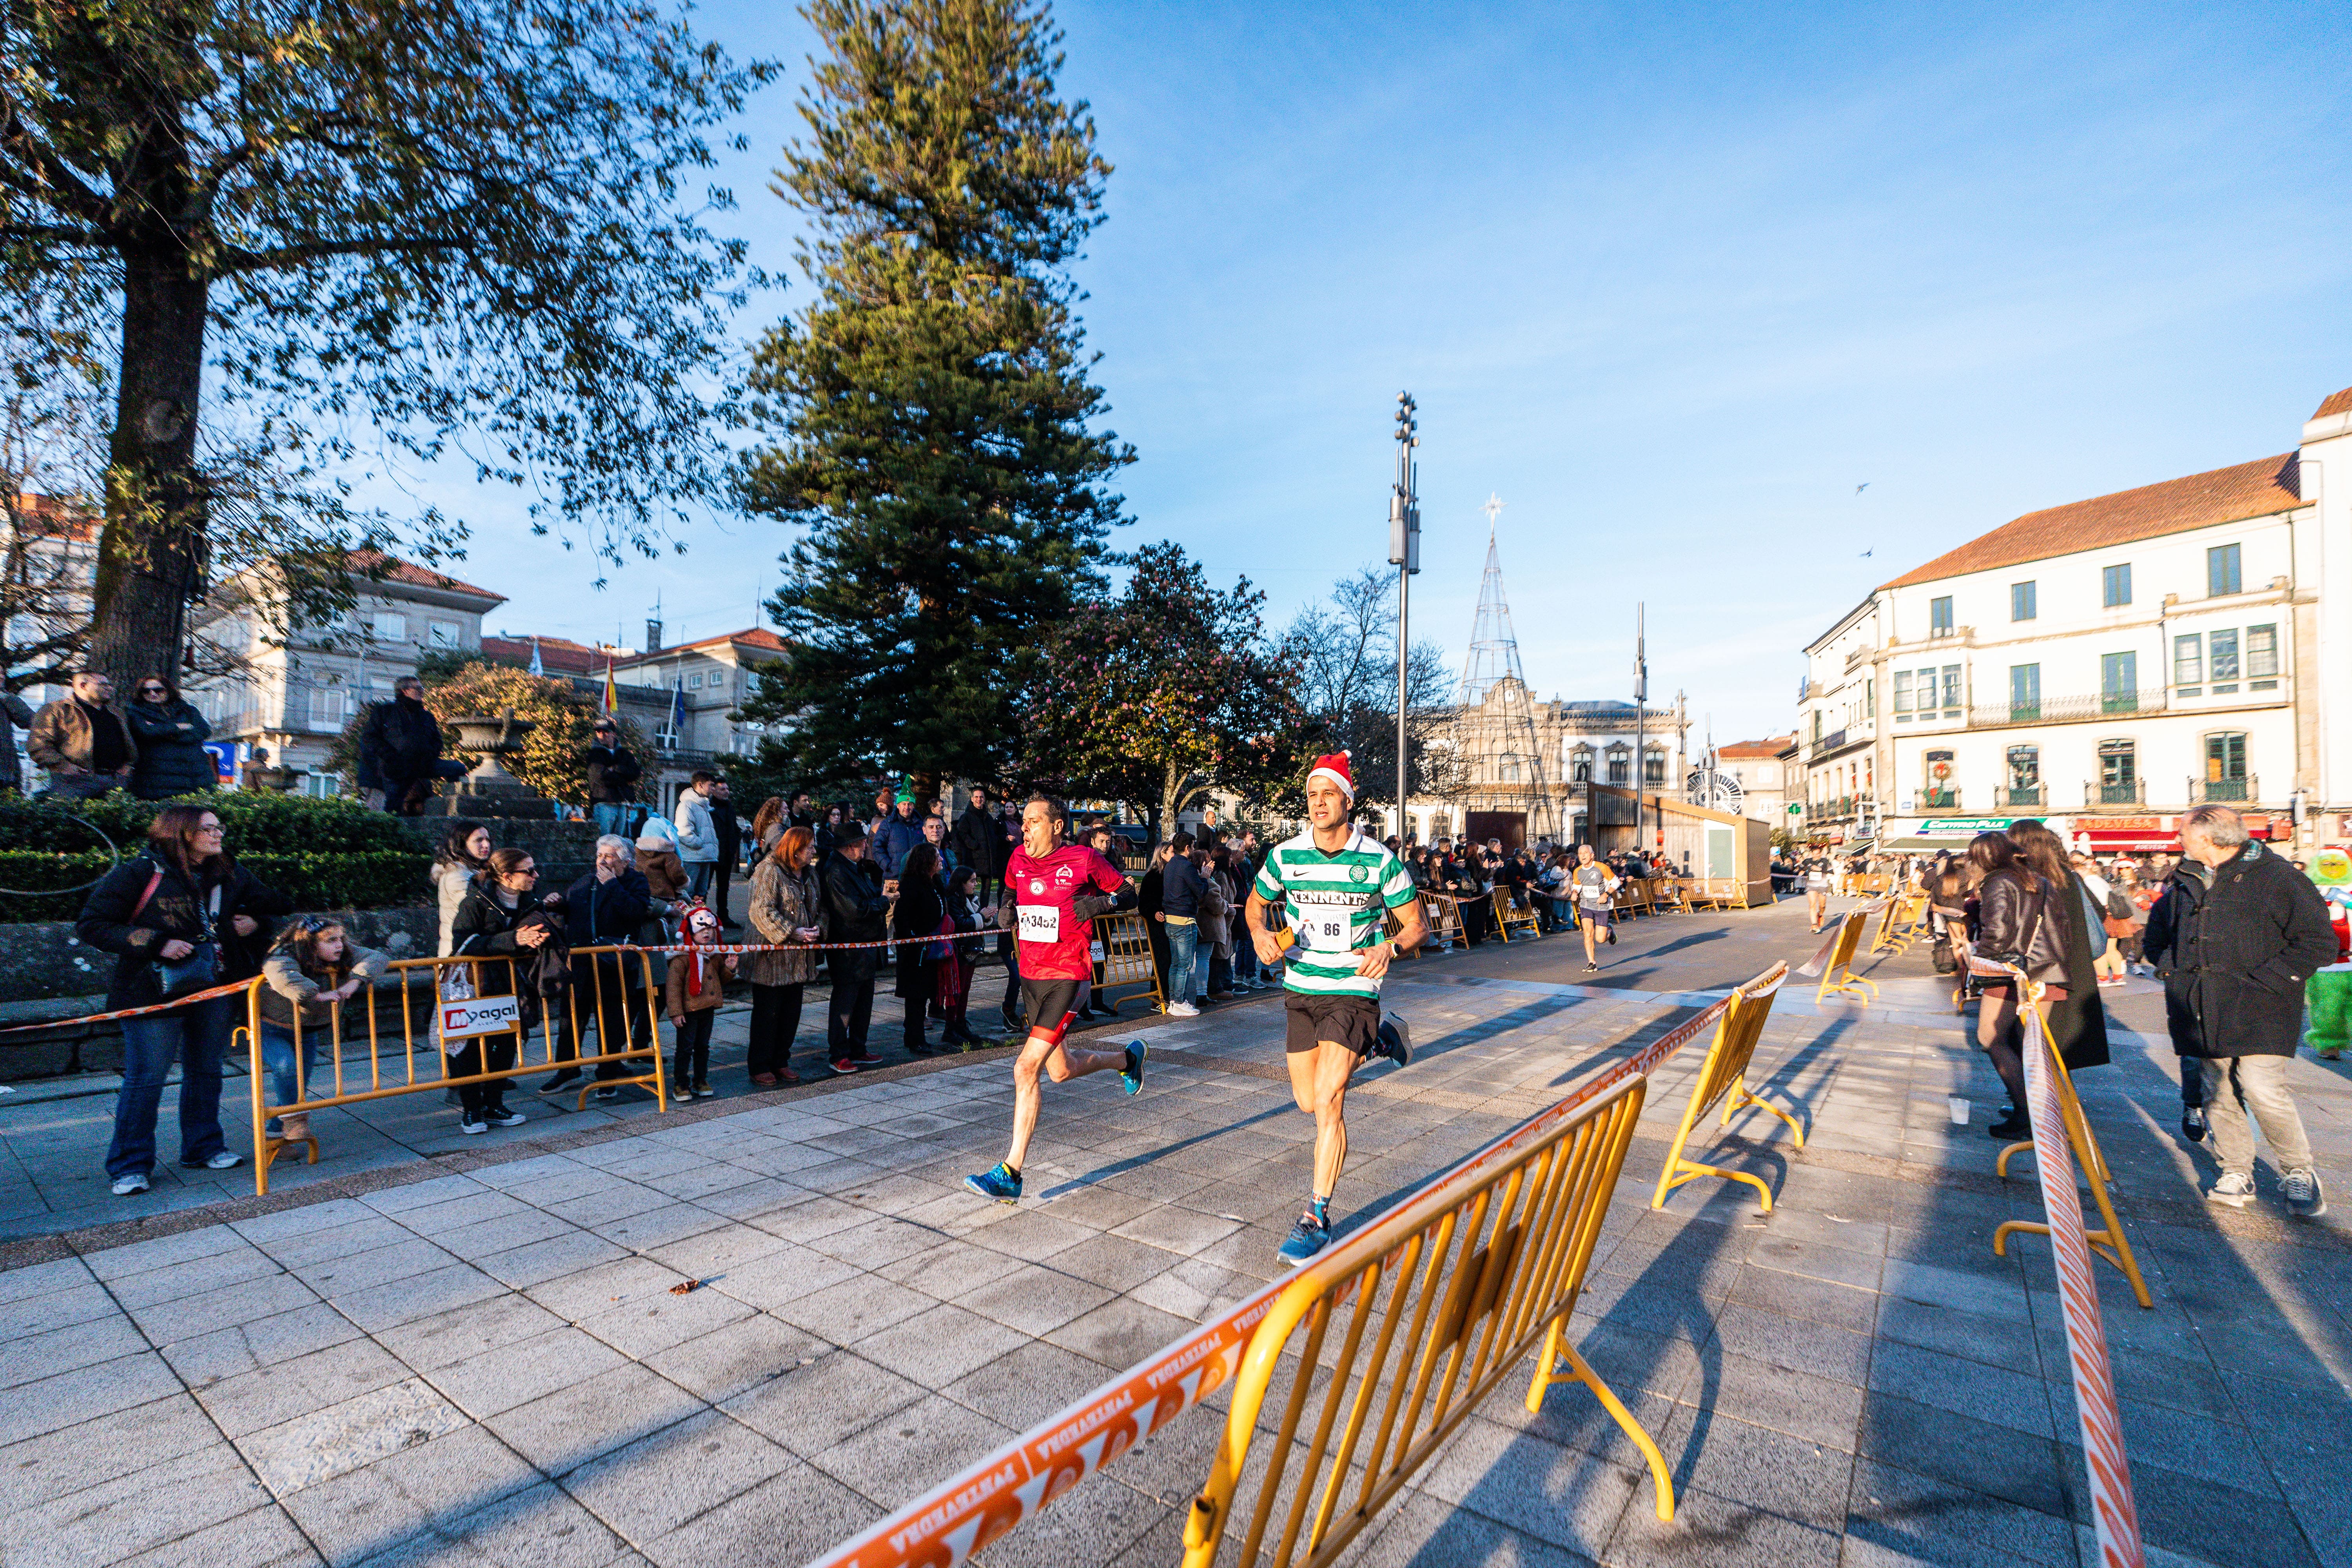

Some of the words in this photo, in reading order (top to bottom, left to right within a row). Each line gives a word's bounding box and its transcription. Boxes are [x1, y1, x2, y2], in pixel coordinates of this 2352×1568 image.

[1291, 890, 1371, 906] TENNENT'S
[1031, 915, 1056, 929] 3452
[1324, 923, 1340, 936] 86
[1090, 946, 1103, 955] agal
